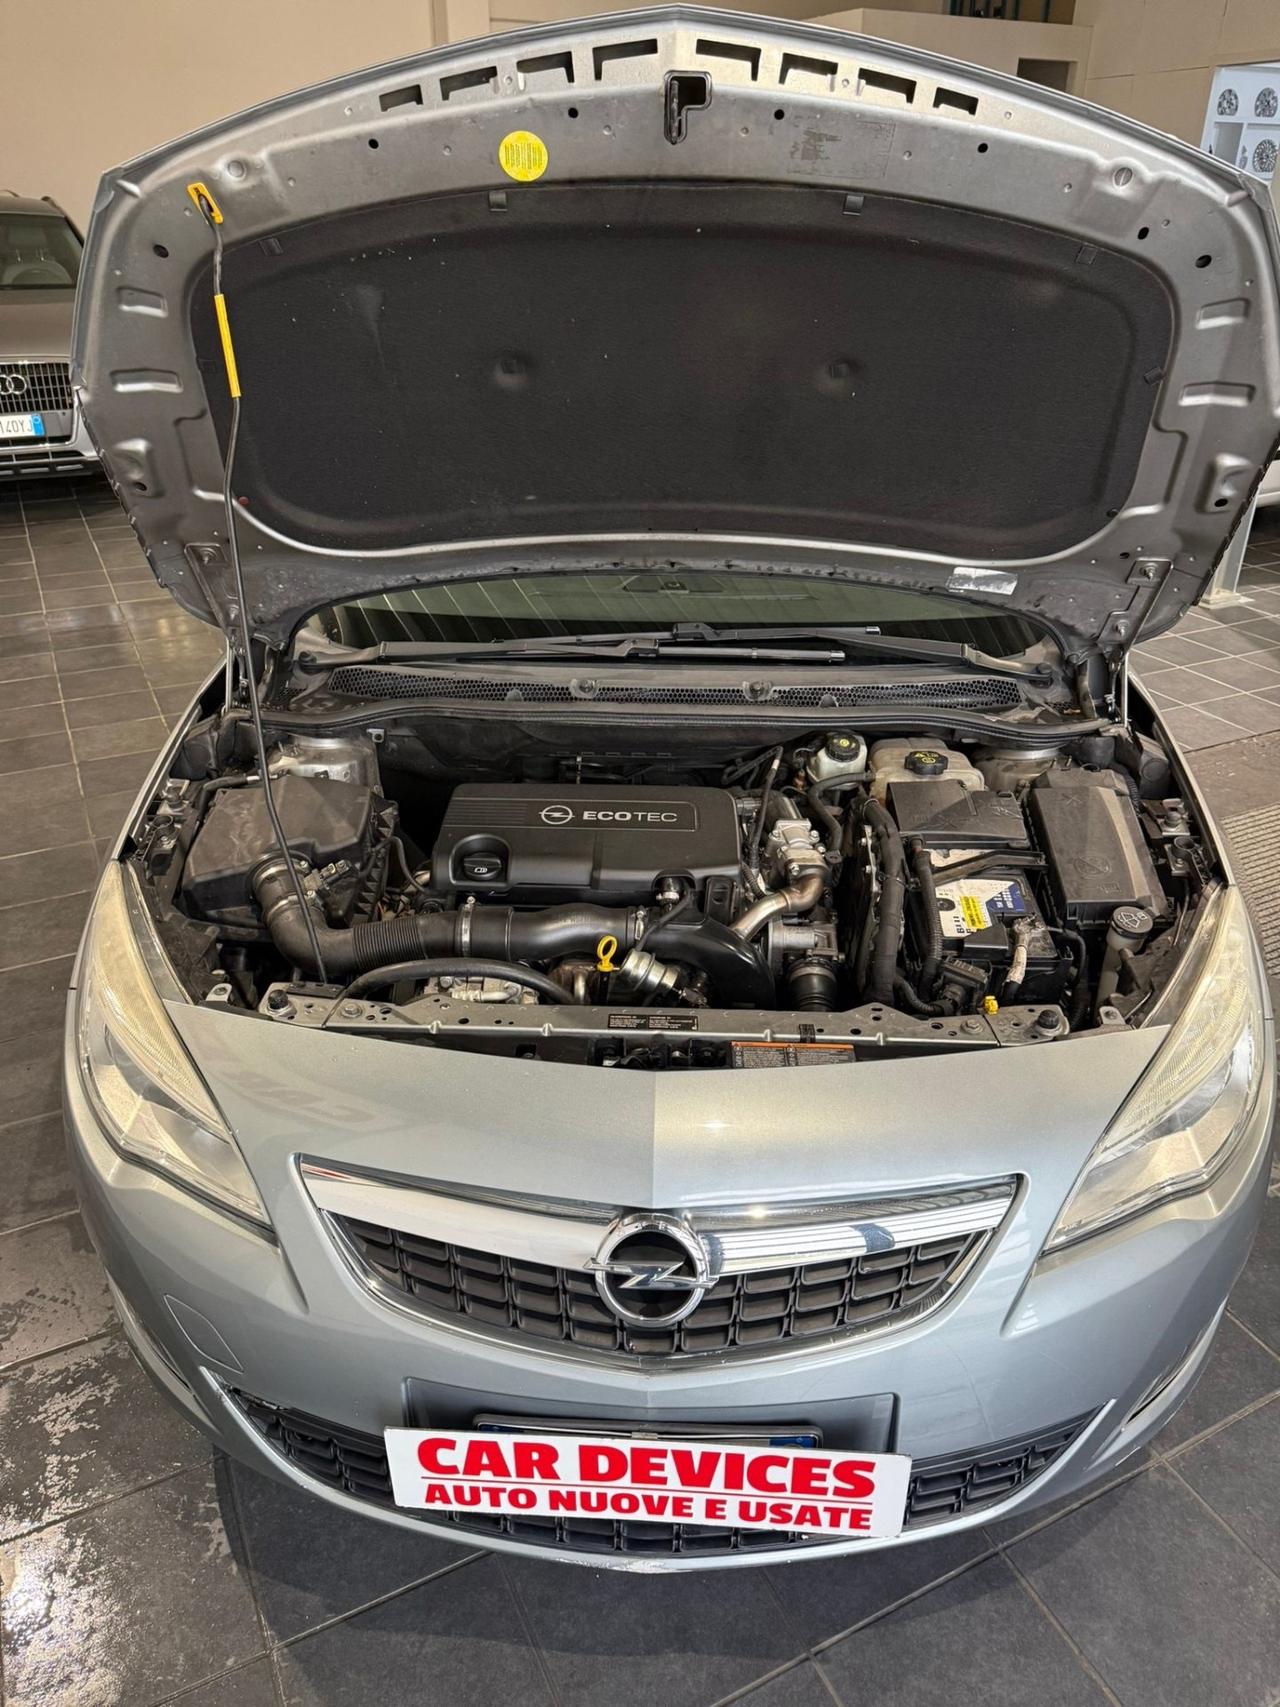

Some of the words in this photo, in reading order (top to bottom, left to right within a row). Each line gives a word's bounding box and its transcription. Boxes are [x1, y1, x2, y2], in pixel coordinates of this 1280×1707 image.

[582, 810, 678, 823] ECOTEC
[417, 1437, 561, 1480] CAR
[578, 1444, 876, 1499] DEVICES
[425, 1483, 538, 1509] AUTO
[548, 1489, 694, 1518] NUOVE
[704, 1498, 727, 1520] E
[738, 1500, 873, 1530] USATE
